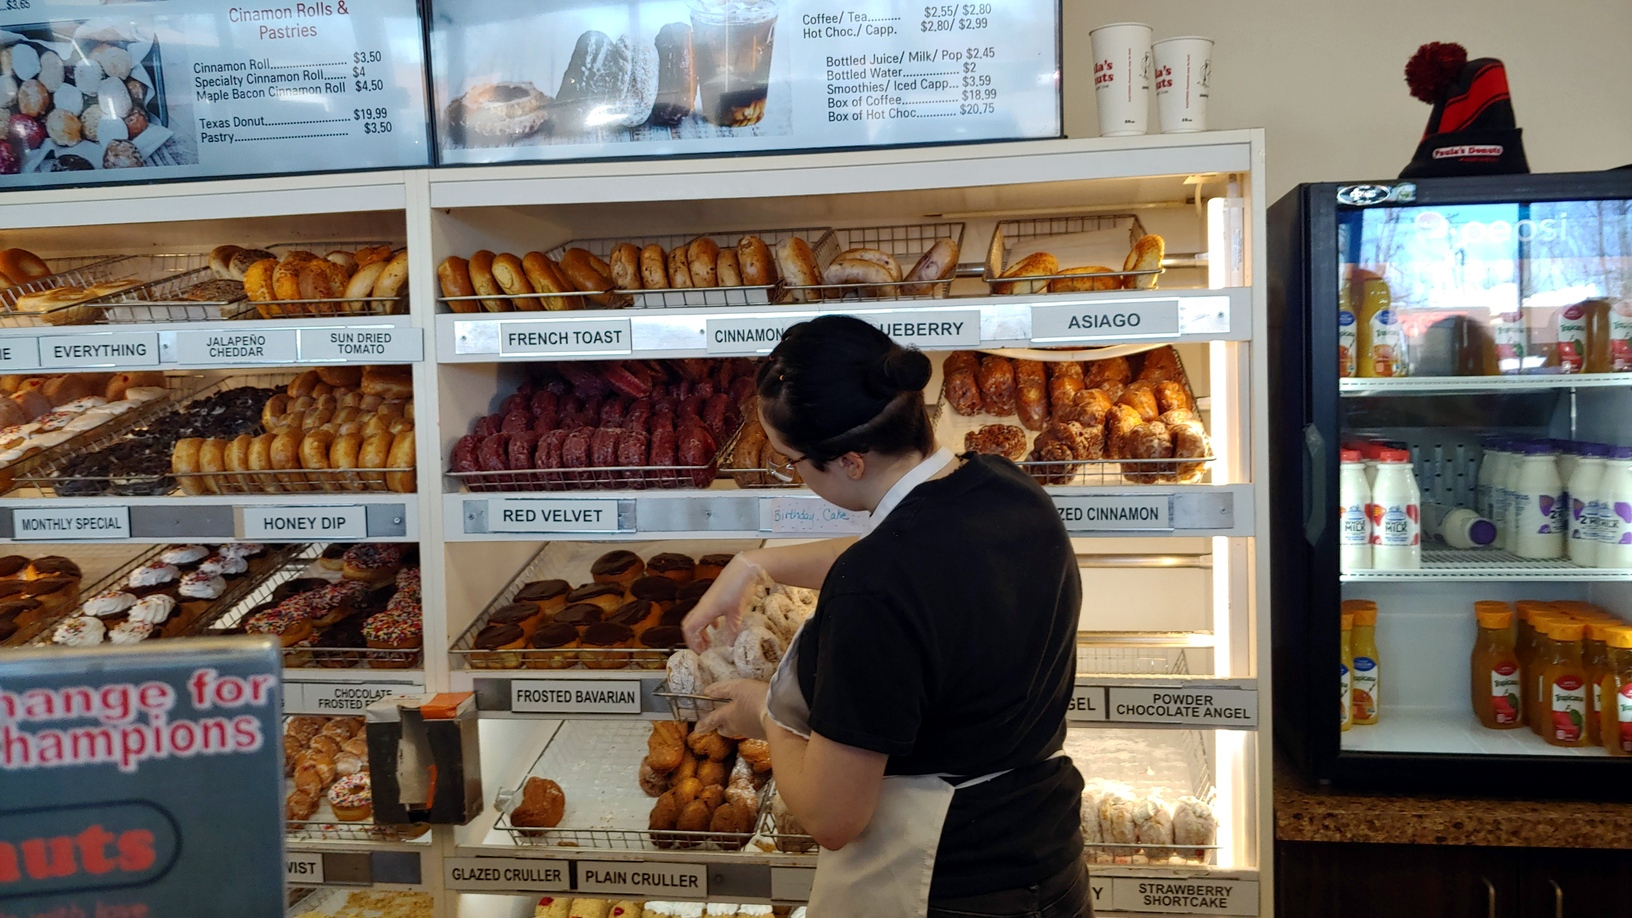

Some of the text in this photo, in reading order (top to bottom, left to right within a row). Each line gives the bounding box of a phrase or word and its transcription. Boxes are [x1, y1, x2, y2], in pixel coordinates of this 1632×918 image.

[229, 0, 349, 23] Cinamon Rolls &
[802, 12, 844, 25] Coffee/
[924, 5, 957, 18] $2.55/
[962, 4, 992, 16] $2.80
[259, 23, 317, 40] Pastries
[803, 18, 988, 39] Hot Choc./ Capp. $2.80/ $2.99
[193, 60, 247, 73] Cinnamon
[353, 51, 382, 64] $3.50
[826, 47, 995, 68] Bottled Juice/ Milk/ Pop $2.45
[195, 74, 243, 88] Specialty
[246, 71, 300, 85] Cinnamon
[353, 67, 365, 79] $4
[826, 69, 866, 81] Bottled
[963, 62, 976, 74] $2
[196, 80, 384, 103] Maple Bacon Cinnamon Roll $4.50
[827, 80, 890, 95] Smoothies/
[894, 78, 917, 91] Iced
[962, 75, 991, 87] $3.59
[828, 97, 849, 109] Box
[851, 95, 863, 107] of
[962, 89, 997, 101] $18.99
[200, 117, 232, 130] Texas
[353, 108, 388, 121] $19.99
[828, 110, 849, 122] Box
[851, 109, 863, 121] of
[866, 108, 886, 120] Hot
[960, 103, 995, 116] $20.75
[364, 122, 392, 135] $3.50
[1068, 313, 1141, 329] ASIAGO
[206, 334, 266, 347] JALAPEÑO
[330, 332, 392, 343] SUN DRIED
[508, 330, 622, 346] FRENCH TOAST
[715, 328, 784, 343] CINNAMON
[54, 344, 147, 358] EVERYTHING
[209, 345, 264, 357] CHEDDAR
[337, 343, 386, 355] TOMATO
[503, 509, 603, 523] RED VELVET
[774, 508, 850, 529] Birthday Cake
[1086, 507, 1159, 521] CINNAMON
[22, 517, 122, 531] MONTHLY SPECIAL
[263, 517, 347, 530] HONEY DIP
[188, 668, 277, 709] for
[318, 699, 362, 709] FROSTED
[517, 689, 635, 704] FROSTED BAVARIAN
[1153, 693, 1214, 706] POWDER
[1116, 704, 1251, 719] CHOCOLATE ANGEL
[452, 868, 562, 883] GLAZED CRULLER
[585, 870, 699, 888] PLAIN CRULLER
[1138, 883, 1233, 897] STRAWBERRY
[1143, 895, 1228, 908] SHORTCAKE
